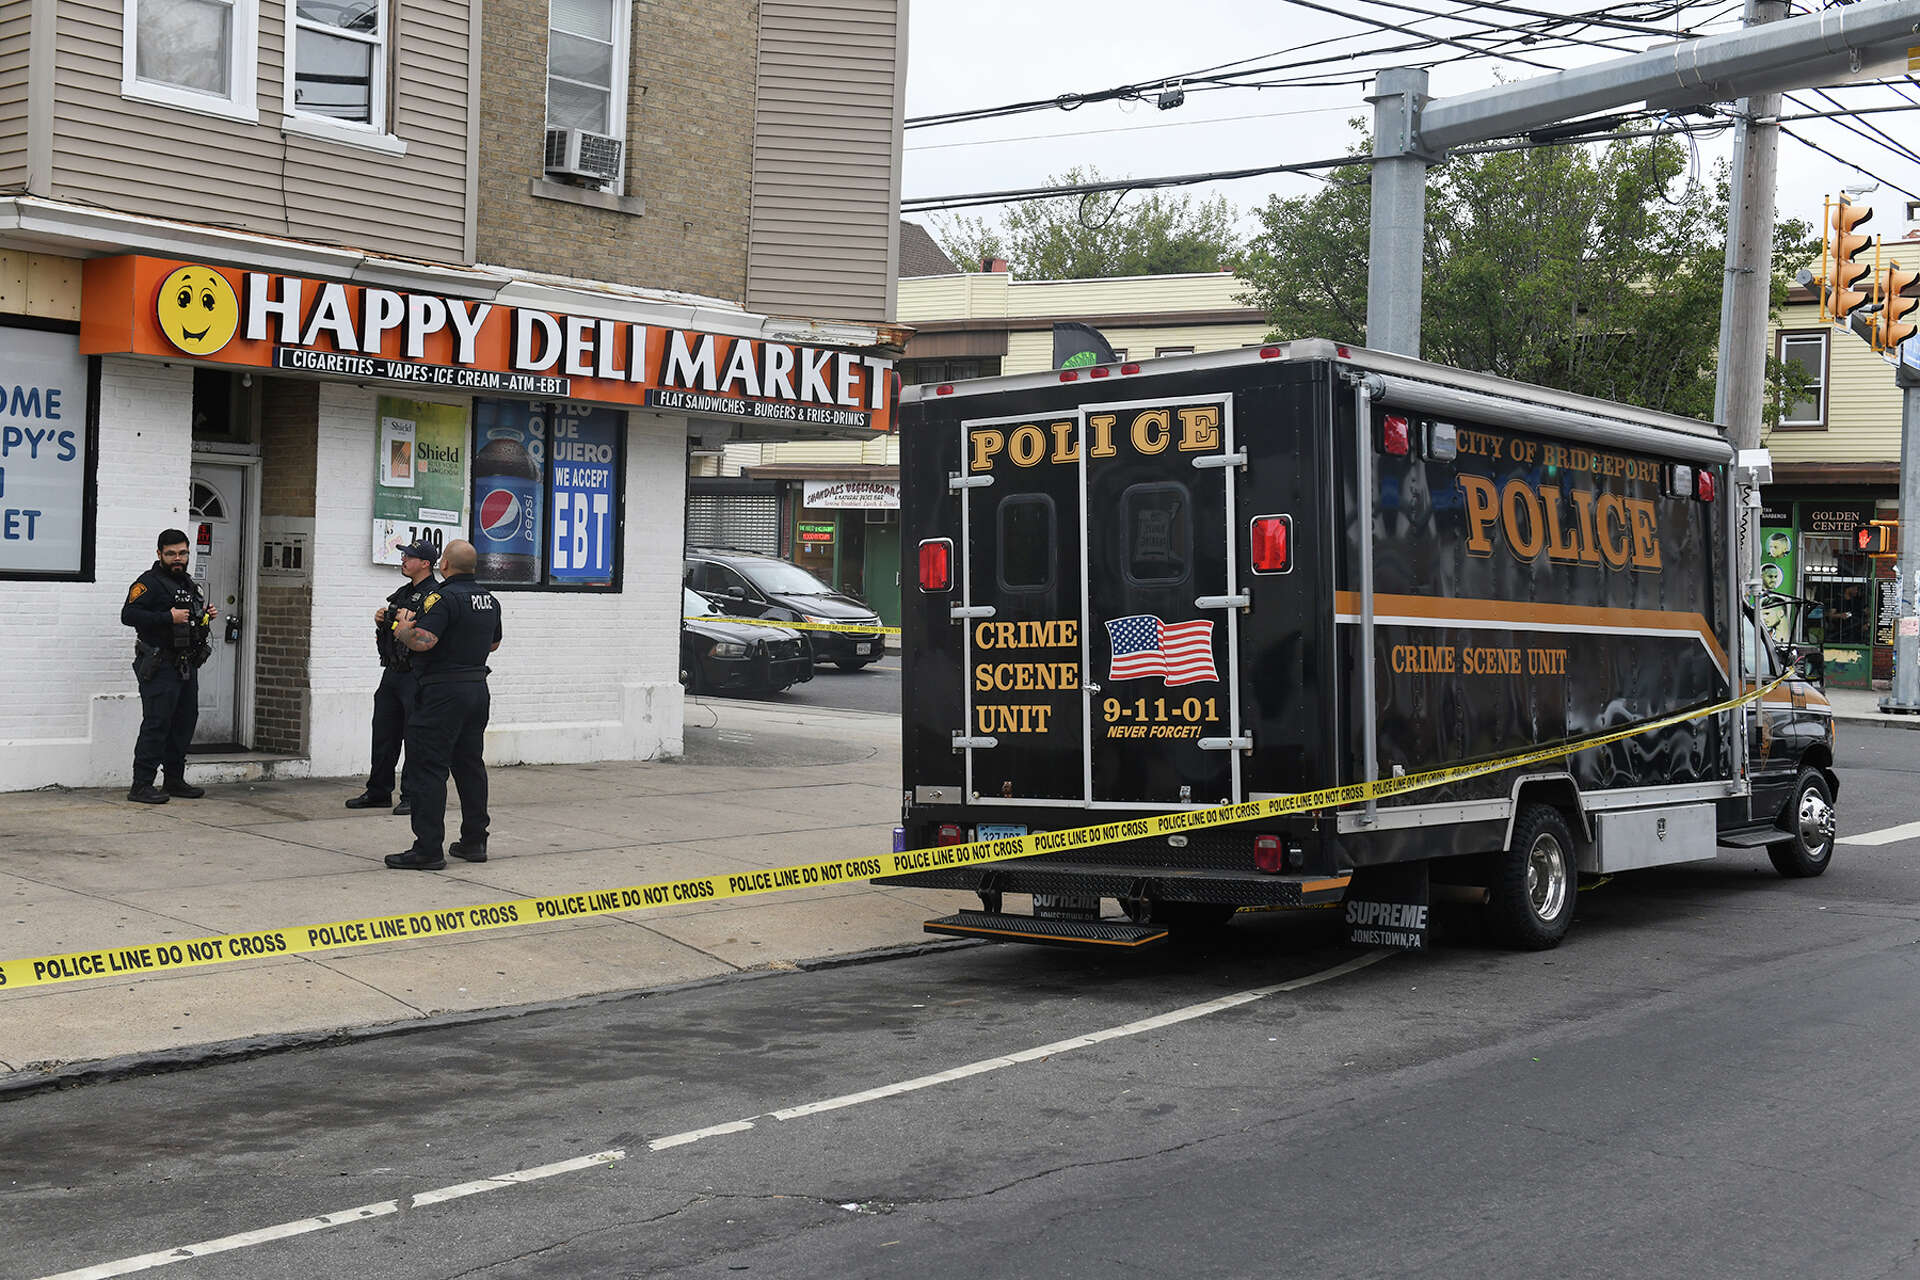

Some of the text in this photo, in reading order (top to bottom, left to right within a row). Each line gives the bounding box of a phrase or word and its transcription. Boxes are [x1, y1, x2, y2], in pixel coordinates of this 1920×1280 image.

[246, 272, 893, 409] HAPPY DELI MARKET
[292, 350, 374, 375] CIGARETTES
[457, 372, 500, 388] CREAM
[660, 391, 684, 407] FLAT
[685, 394, 745, 415] SANDWICHES
[754, 404, 796, 420] BURGERS
[798, 409, 804, 420] &
[417, 442, 459, 463] Shield
[971, 406, 1219, 471] POLICE
[1456, 429, 1660, 484] CITY OF BRIDGEPORT
[555, 467, 608, 488] WE ACCEPT
[524, 494, 534, 541] pepsi
[553, 492, 609, 569] EBT
[1456, 472, 1663, 574] POLICE
[1812, 511, 1860, 521] GOLDEN
[471, 594, 493, 610] POLICE
[975, 620, 1078, 650] CRIME
[1391, 644, 1568, 675] CRIME SCENE UNIT
[976, 662, 1079, 691] SCENE
[976, 704, 1052, 733] UNIT
[1103, 697, 1220, 722] 9-11-01
[1107, 725, 1202, 738] NEVER FORGET!
[1268, 786, 1364, 813] POLICE LINE DO NOT CROSS
[1158, 803, 1260, 831] POLICE LINE DO NOT CROSS
[1035, 821, 1148, 850] POLICE LINE DO NOT CROSS
[894, 840, 1024, 871] POLICE LINE DO NOT CROSS
[729, 858, 881, 893] POLICE LINE DO NOT CROSS
[536, 880, 714, 918] POLICE LINE DO NOT CROSS
[307, 904, 518, 947] POLICE LINE DO NOT CROSS
[1345, 900, 1428, 929] SUPREME
[1351, 929, 1421, 948] JONESTOWN,PA
[33, 954, 105, 980] POLICE
[108, 949, 154, 972] LINE
[158, 945, 183, 966] DO
[187, 940, 223, 961] NOT
[228, 933, 287, 956] CROSS
